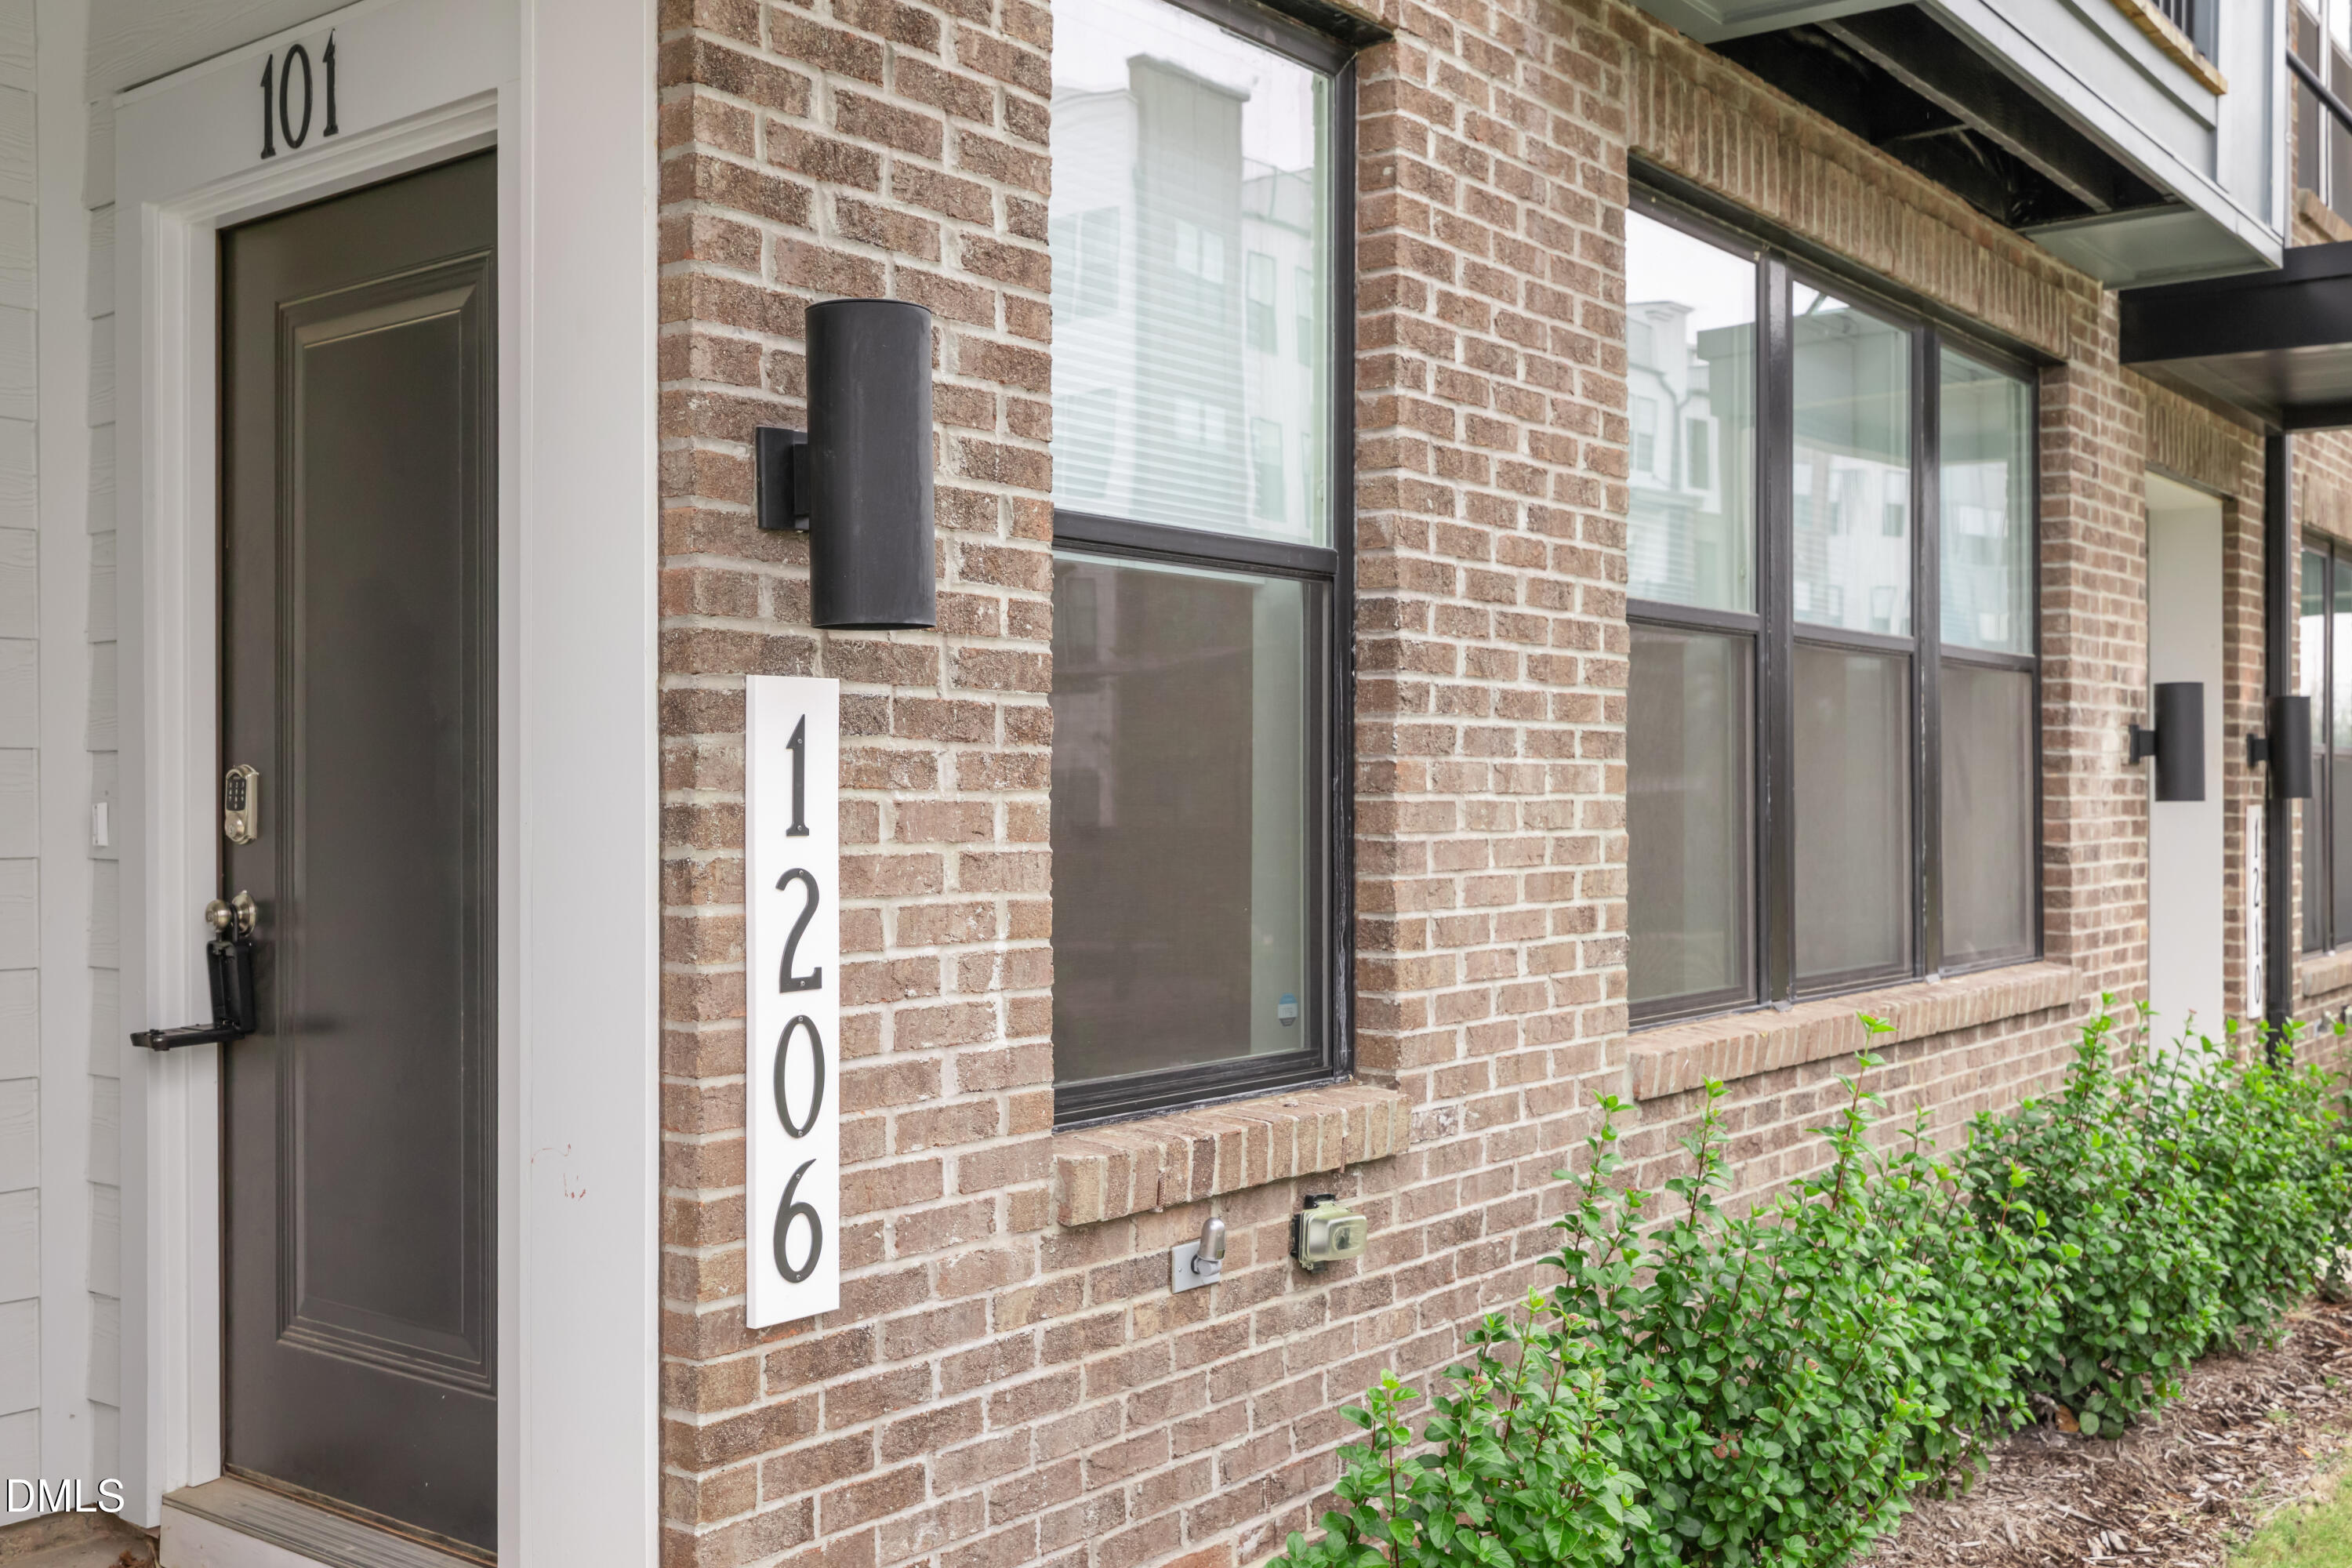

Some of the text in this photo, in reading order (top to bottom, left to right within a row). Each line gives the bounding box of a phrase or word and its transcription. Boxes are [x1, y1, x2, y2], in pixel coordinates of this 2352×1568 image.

[260, 27, 339, 159] 101
[773, 713, 826, 1284] 1206
[2252, 817, 2262, 1004] 1210
